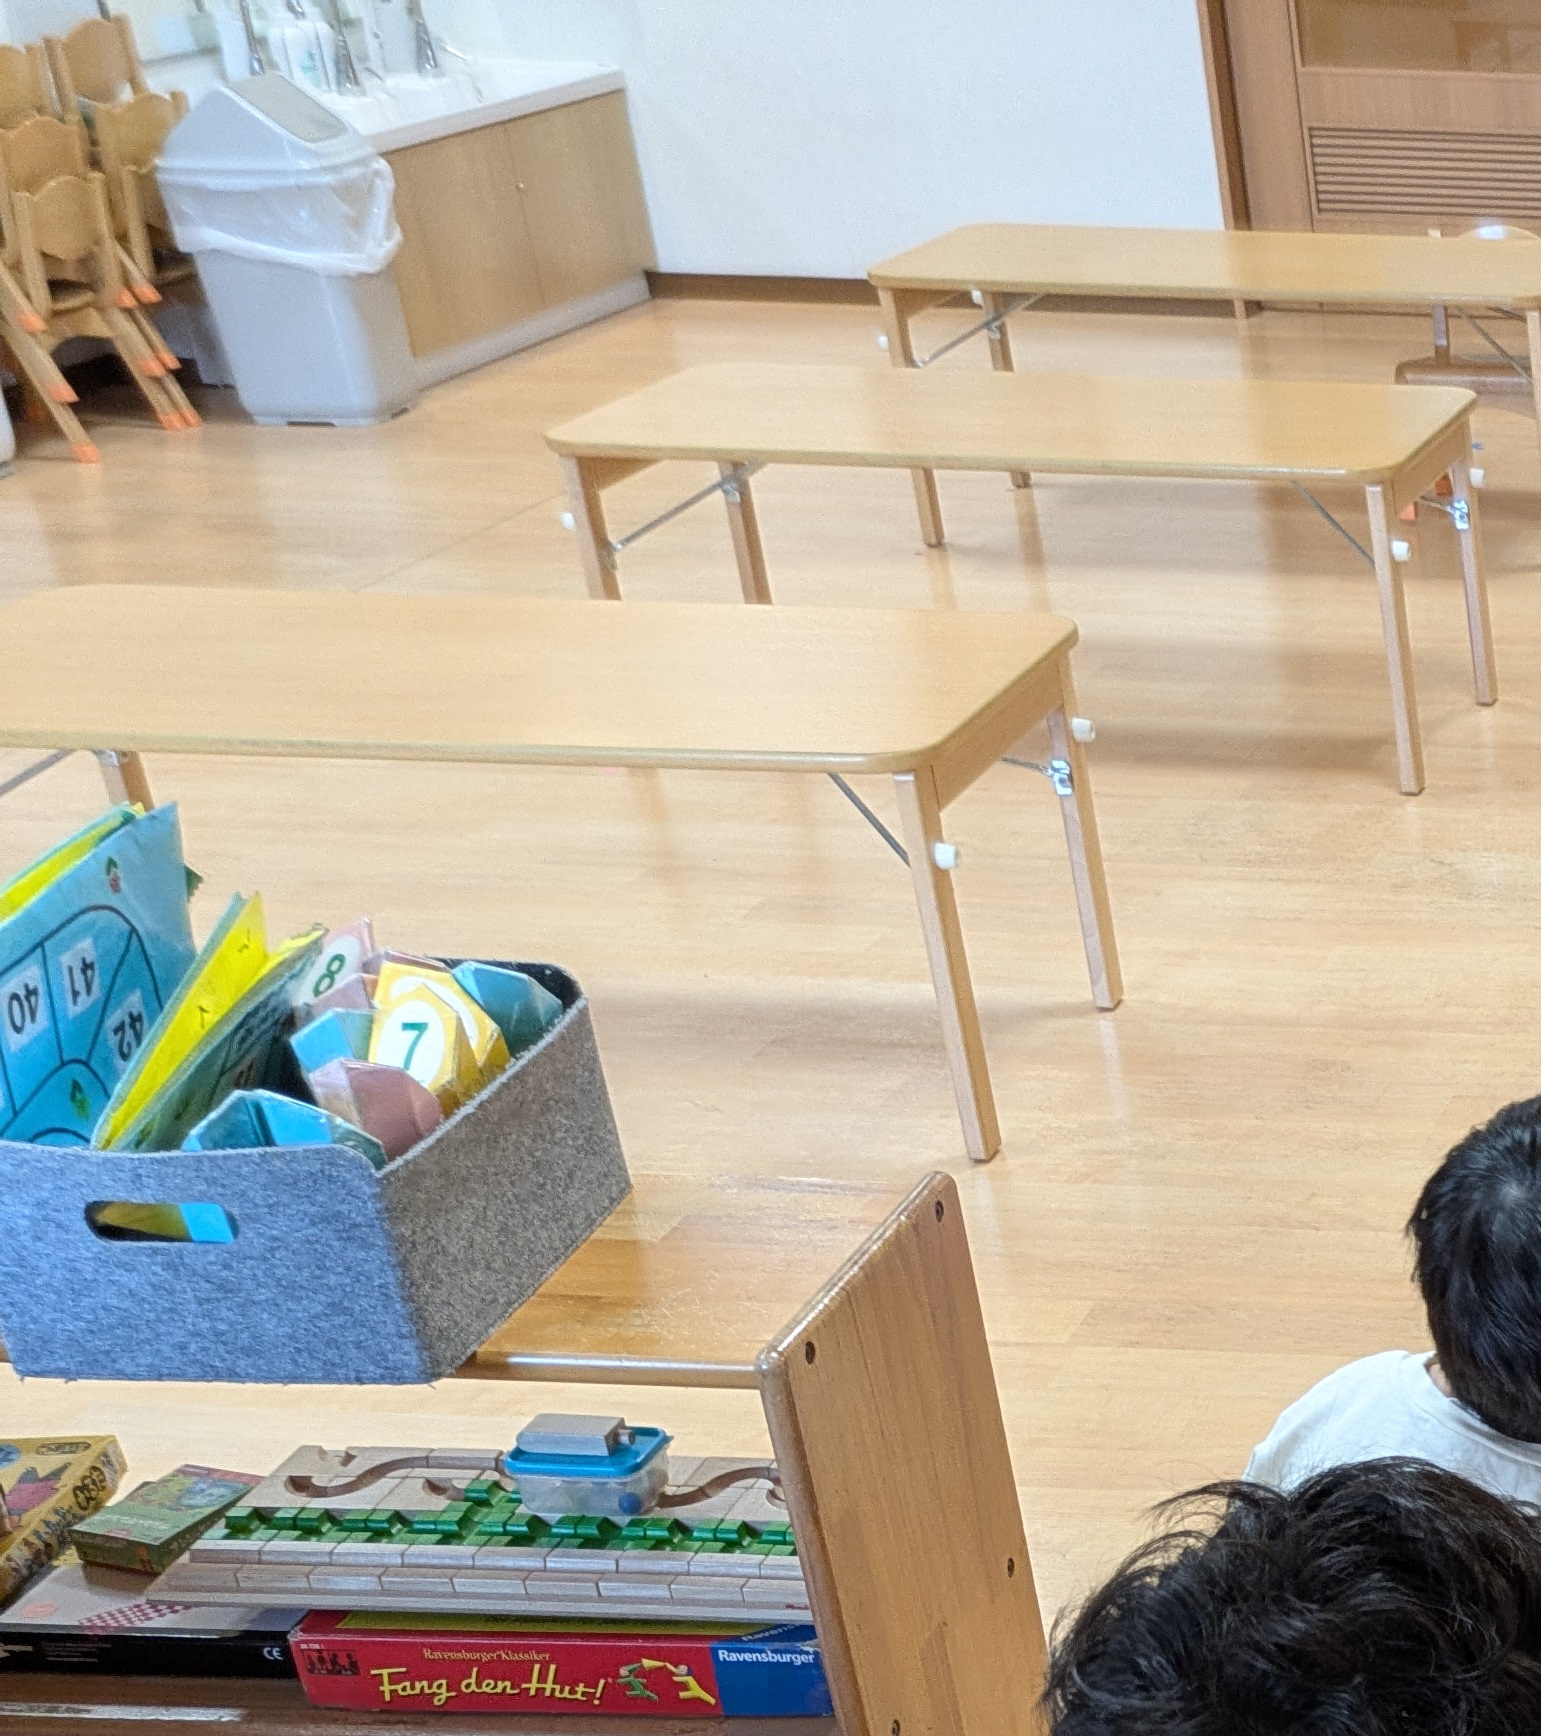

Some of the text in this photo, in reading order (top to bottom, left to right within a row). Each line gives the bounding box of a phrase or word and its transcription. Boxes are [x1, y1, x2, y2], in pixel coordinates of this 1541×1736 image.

[67, 956, 95, 1006] 41
[313, 953, 346, 997] 8
[7, 982, 39, 1035] 40
[113, 1011, 143, 1062] 42
[401, 1022, 429, 1071] 7
[718, 1649, 815, 1665] Ravensburger
[370, 1663, 605, 1705] Fang den Hut!
